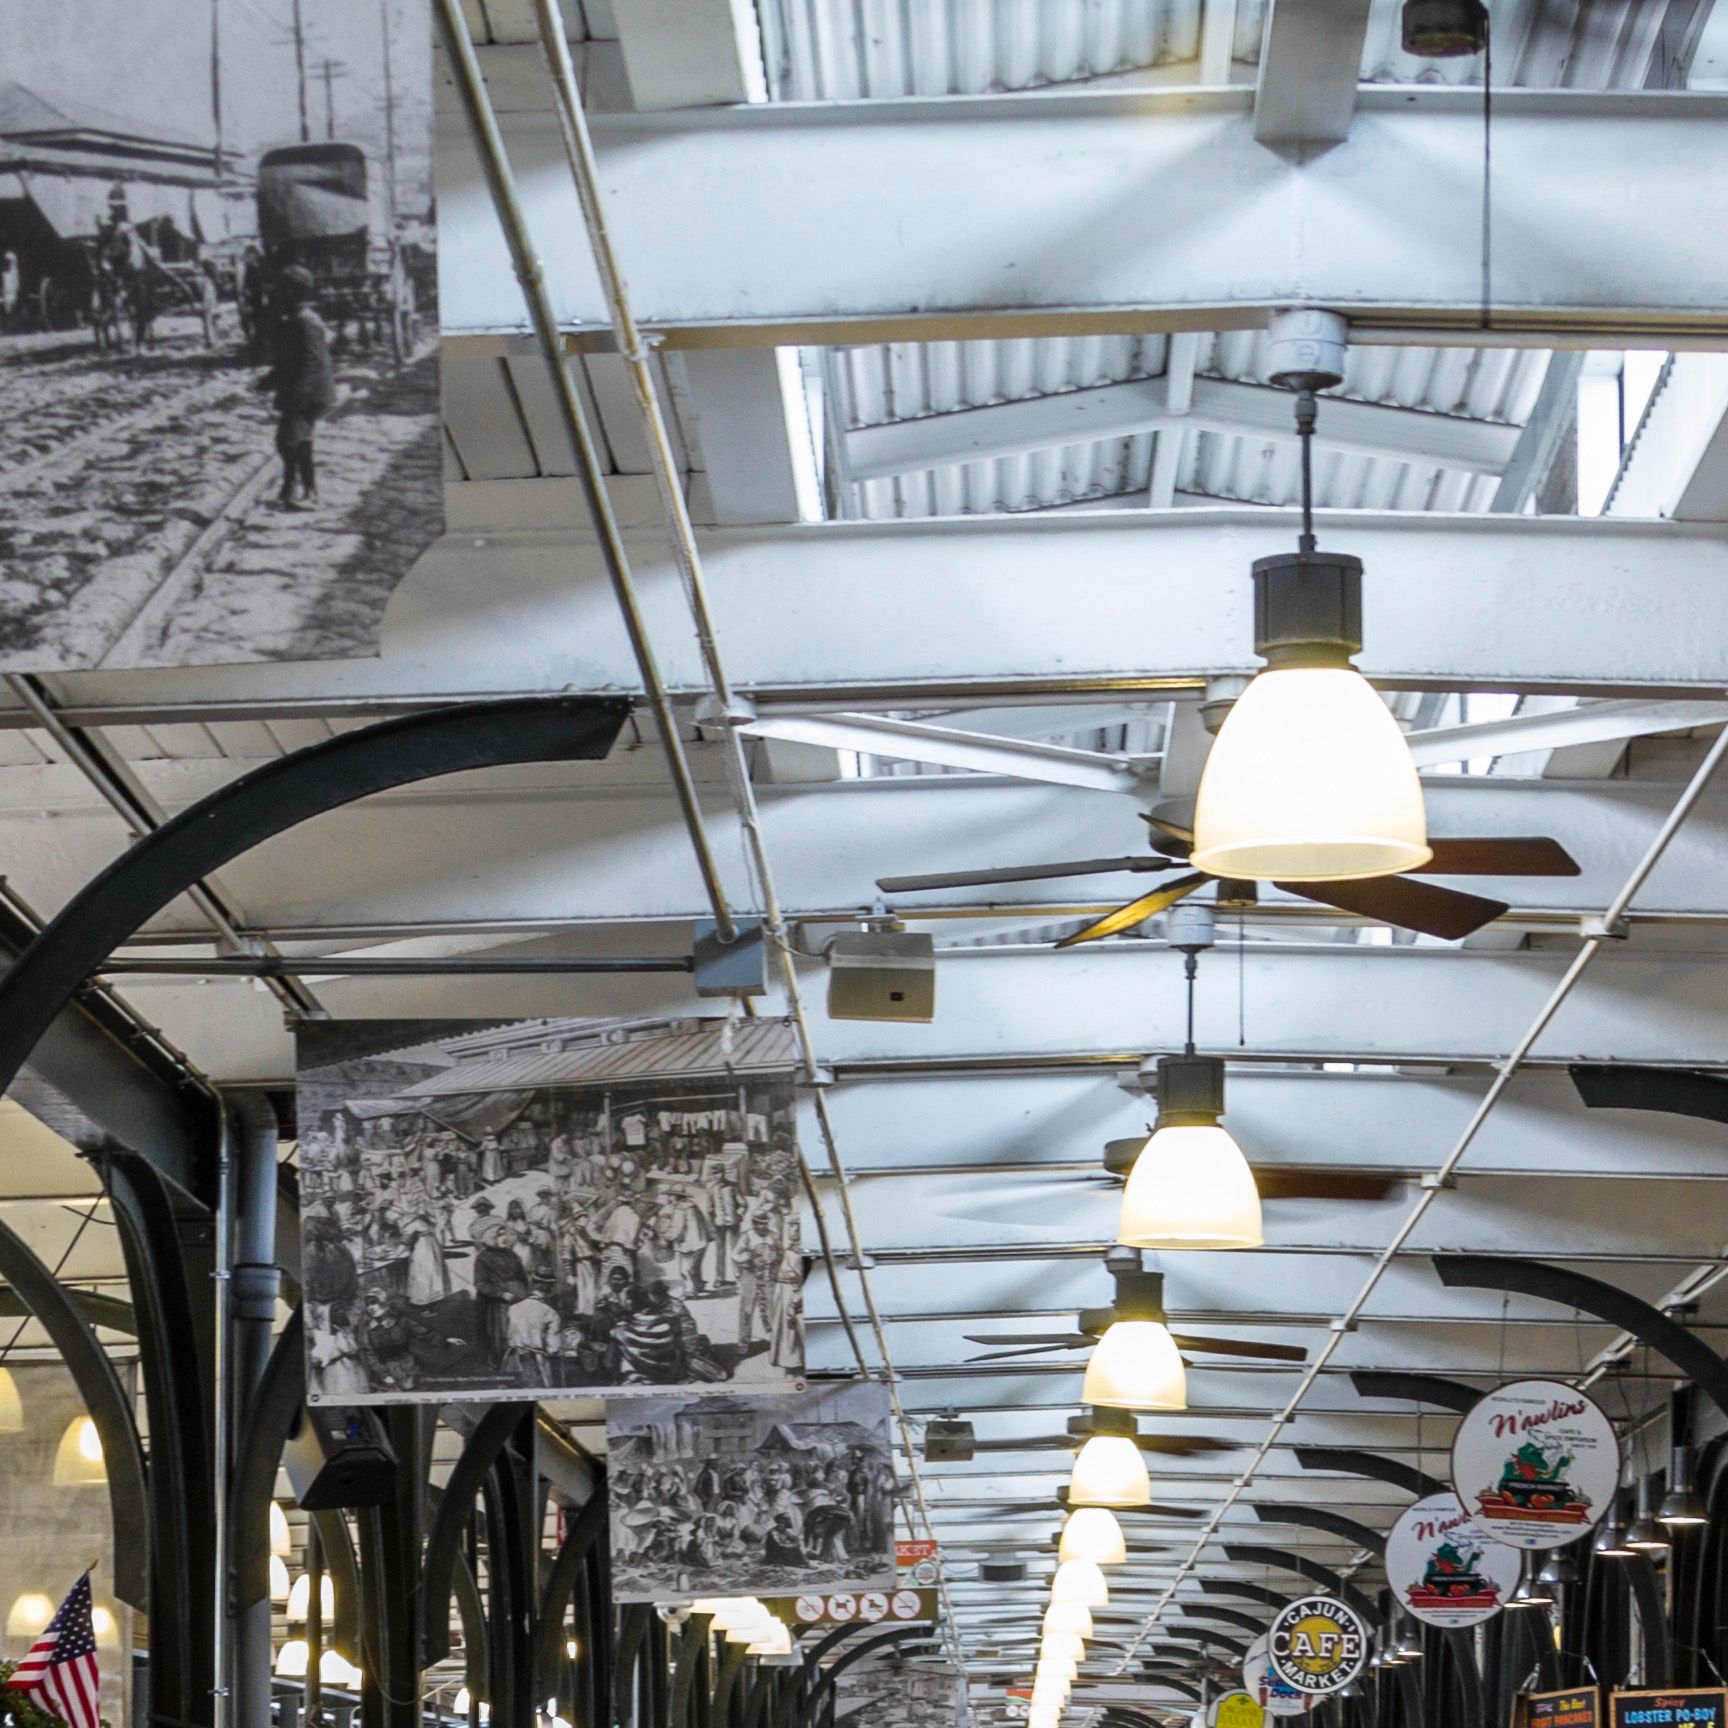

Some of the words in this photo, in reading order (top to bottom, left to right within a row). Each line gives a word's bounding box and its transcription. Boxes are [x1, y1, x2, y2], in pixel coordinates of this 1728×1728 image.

[1489, 1399, 1587, 1438] N'awlins
[1287, 1602, 1349, 1624] CAJUN
[1282, 1661, 1352, 1688] MARKET
[1624, 1710, 1672, 1724] LOBSTER
[1676, 1707, 1716, 1722] PO-BOY
